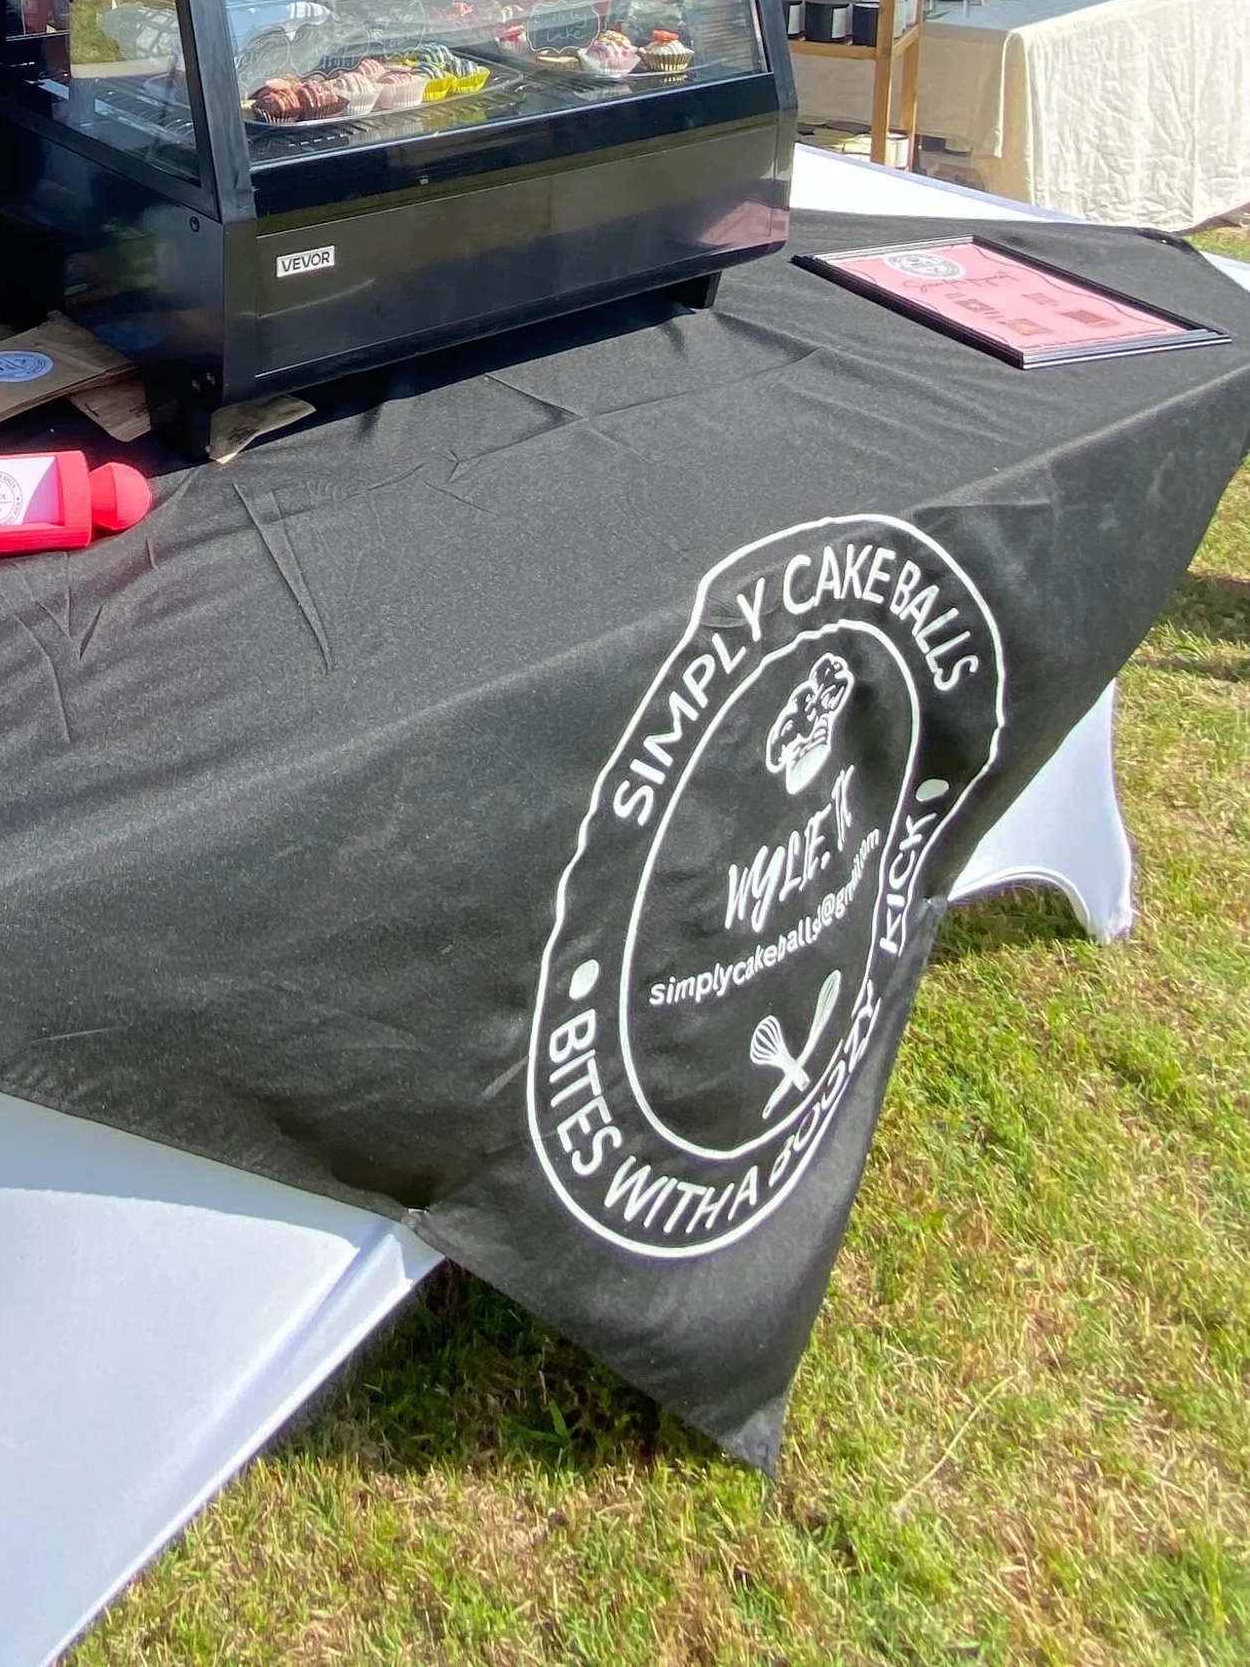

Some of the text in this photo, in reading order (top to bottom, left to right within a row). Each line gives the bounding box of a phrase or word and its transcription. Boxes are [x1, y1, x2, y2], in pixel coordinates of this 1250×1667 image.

[281, 251, 331, 272] VEVOR
[613, 543, 979, 826] SIMPLY CAKE BALLS
[549, 1008, 622, 1176] BITES
[604, 1155, 735, 1234] WITH
[728, 1165, 758, 1221] A
[879, 812, 937, 957] KICK
